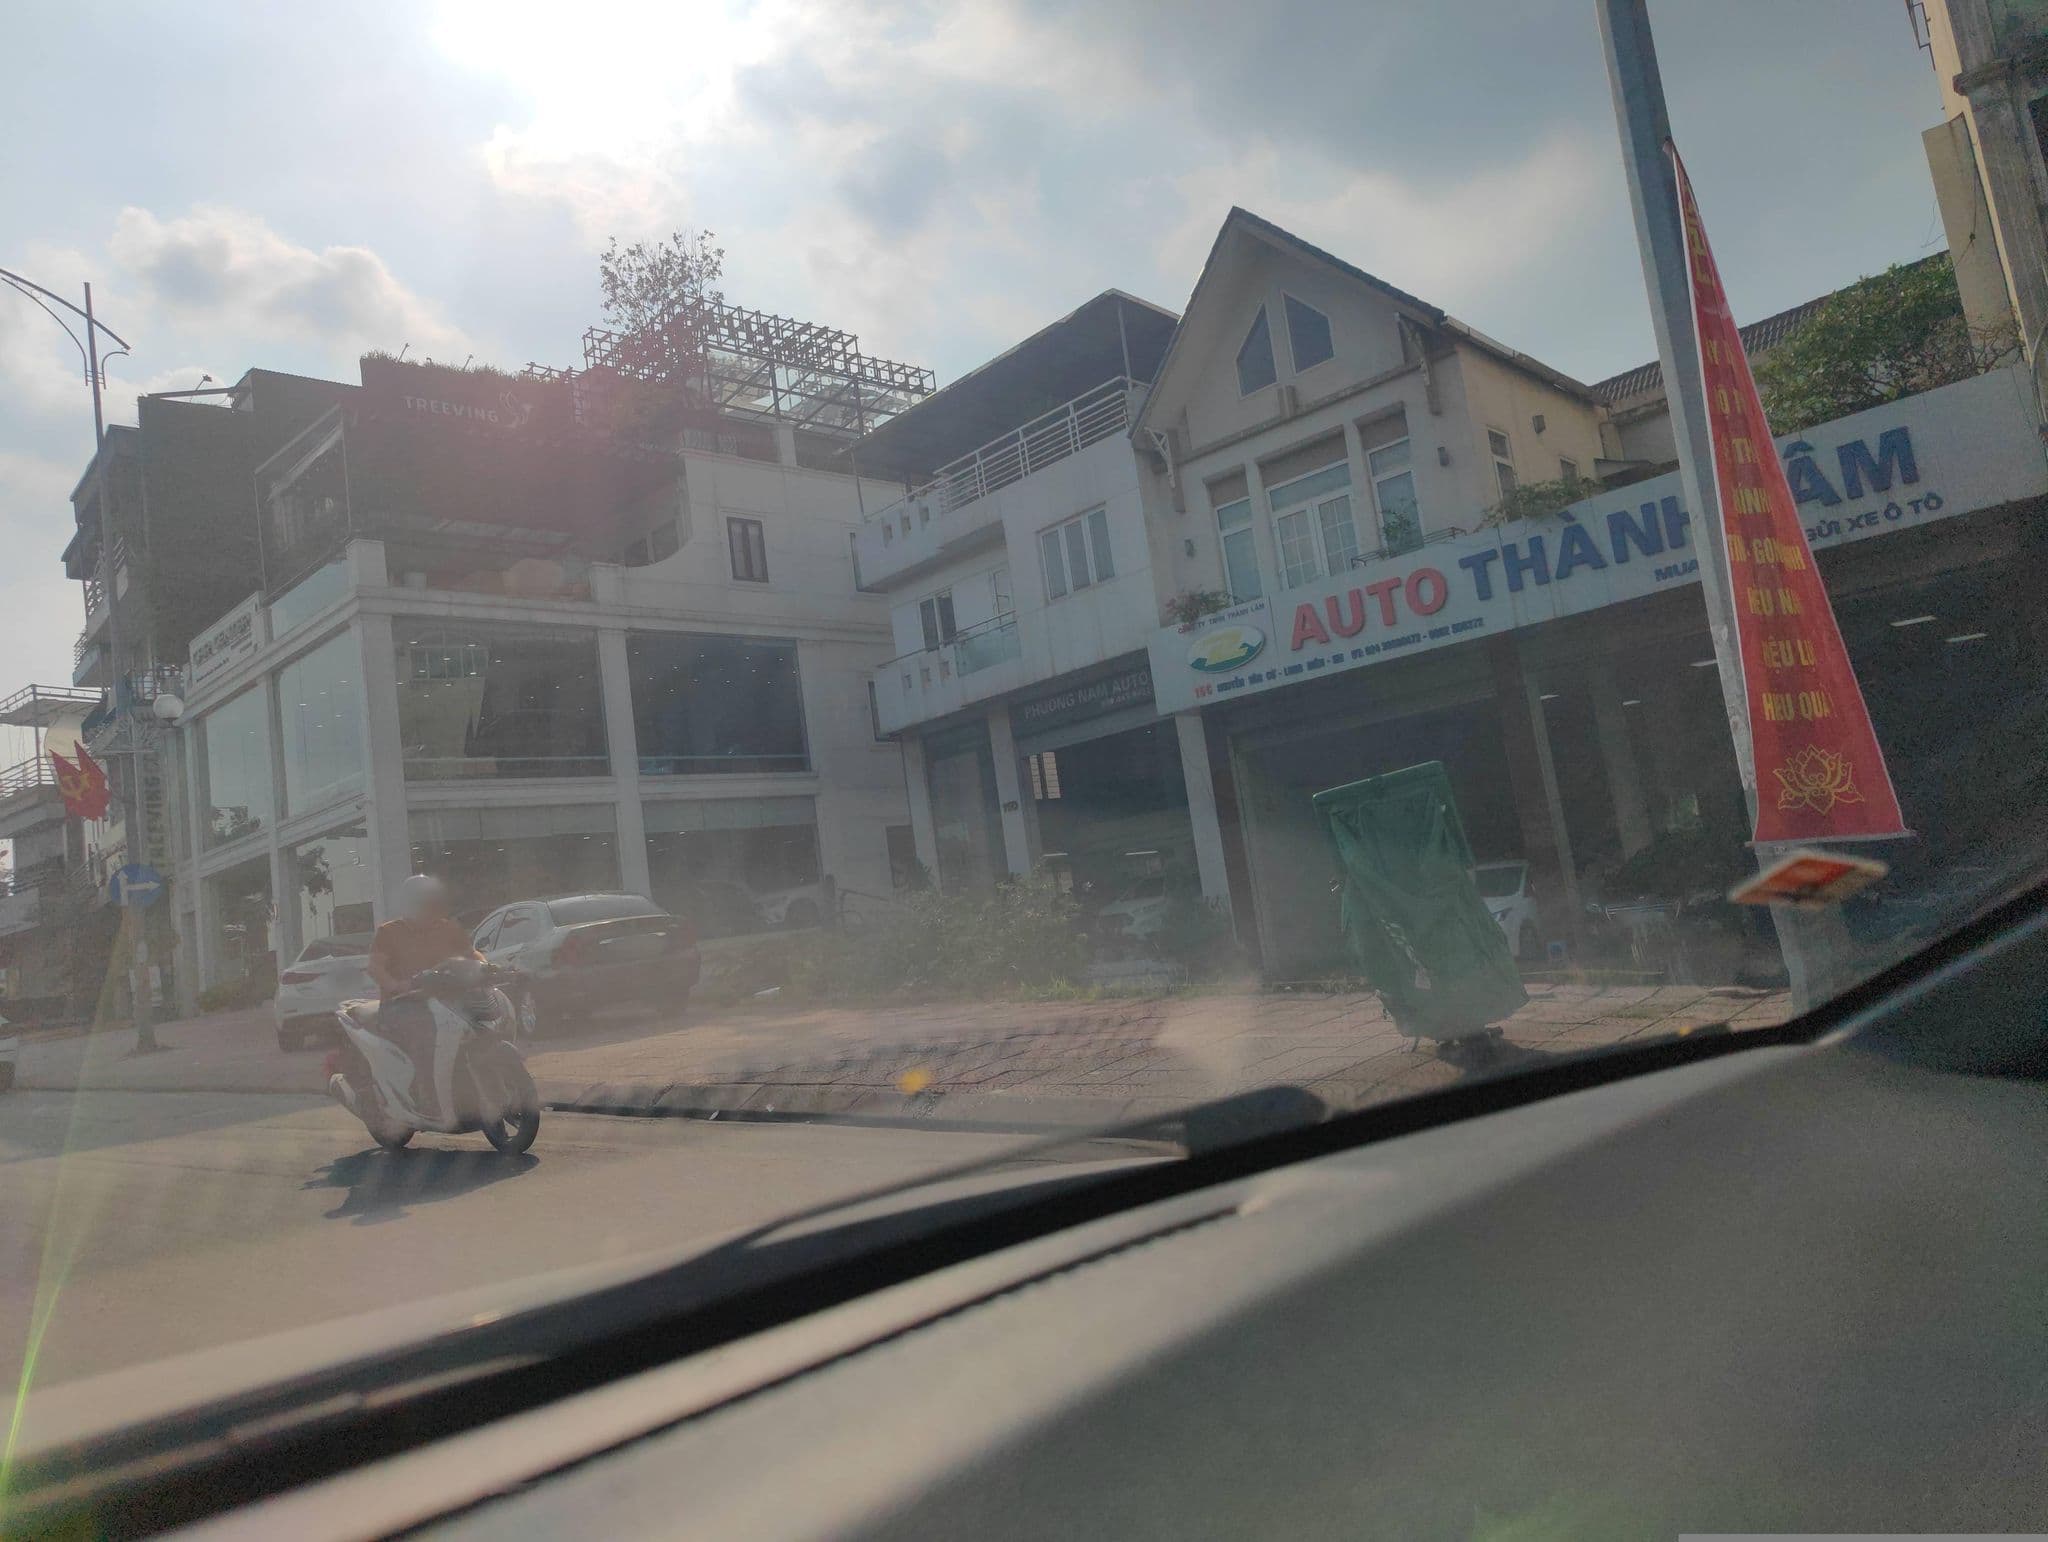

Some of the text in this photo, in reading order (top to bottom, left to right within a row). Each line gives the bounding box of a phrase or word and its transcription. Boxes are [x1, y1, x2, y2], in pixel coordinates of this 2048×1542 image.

[403, 395, 499, 424] TREEVING
[1290, 425, 1920, 652] AUTO THÀNH ÂM
[1654, 559, 1699, 582] MUA
[1848, 509, 1881, 532] XE
[1884, 501, 1902, 521] Ô
[1906, 491, 1944, 516] TÔ
[1112, 671, 1149, 693] AUTO
